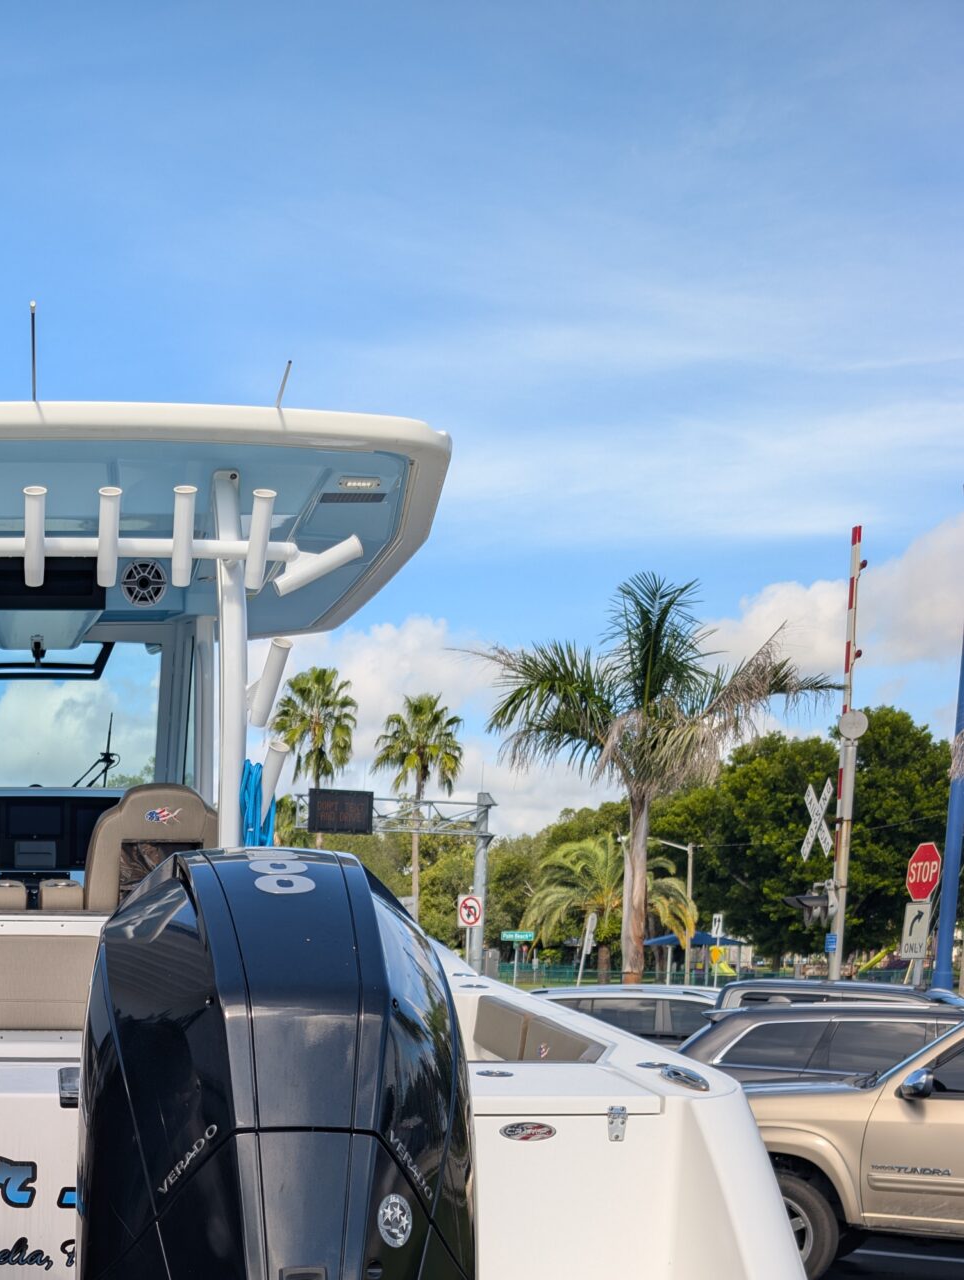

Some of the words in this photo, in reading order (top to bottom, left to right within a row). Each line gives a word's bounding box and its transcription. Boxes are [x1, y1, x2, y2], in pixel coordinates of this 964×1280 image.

[909, 861, 938, 883] STOP
[904, 943, 923, 954] ONLY
[157, 1124, 217, 1194] VERADO
[390, 1129, 433, 1200] VERADO
[895, 1166, 951, 1176] TUNDRA
